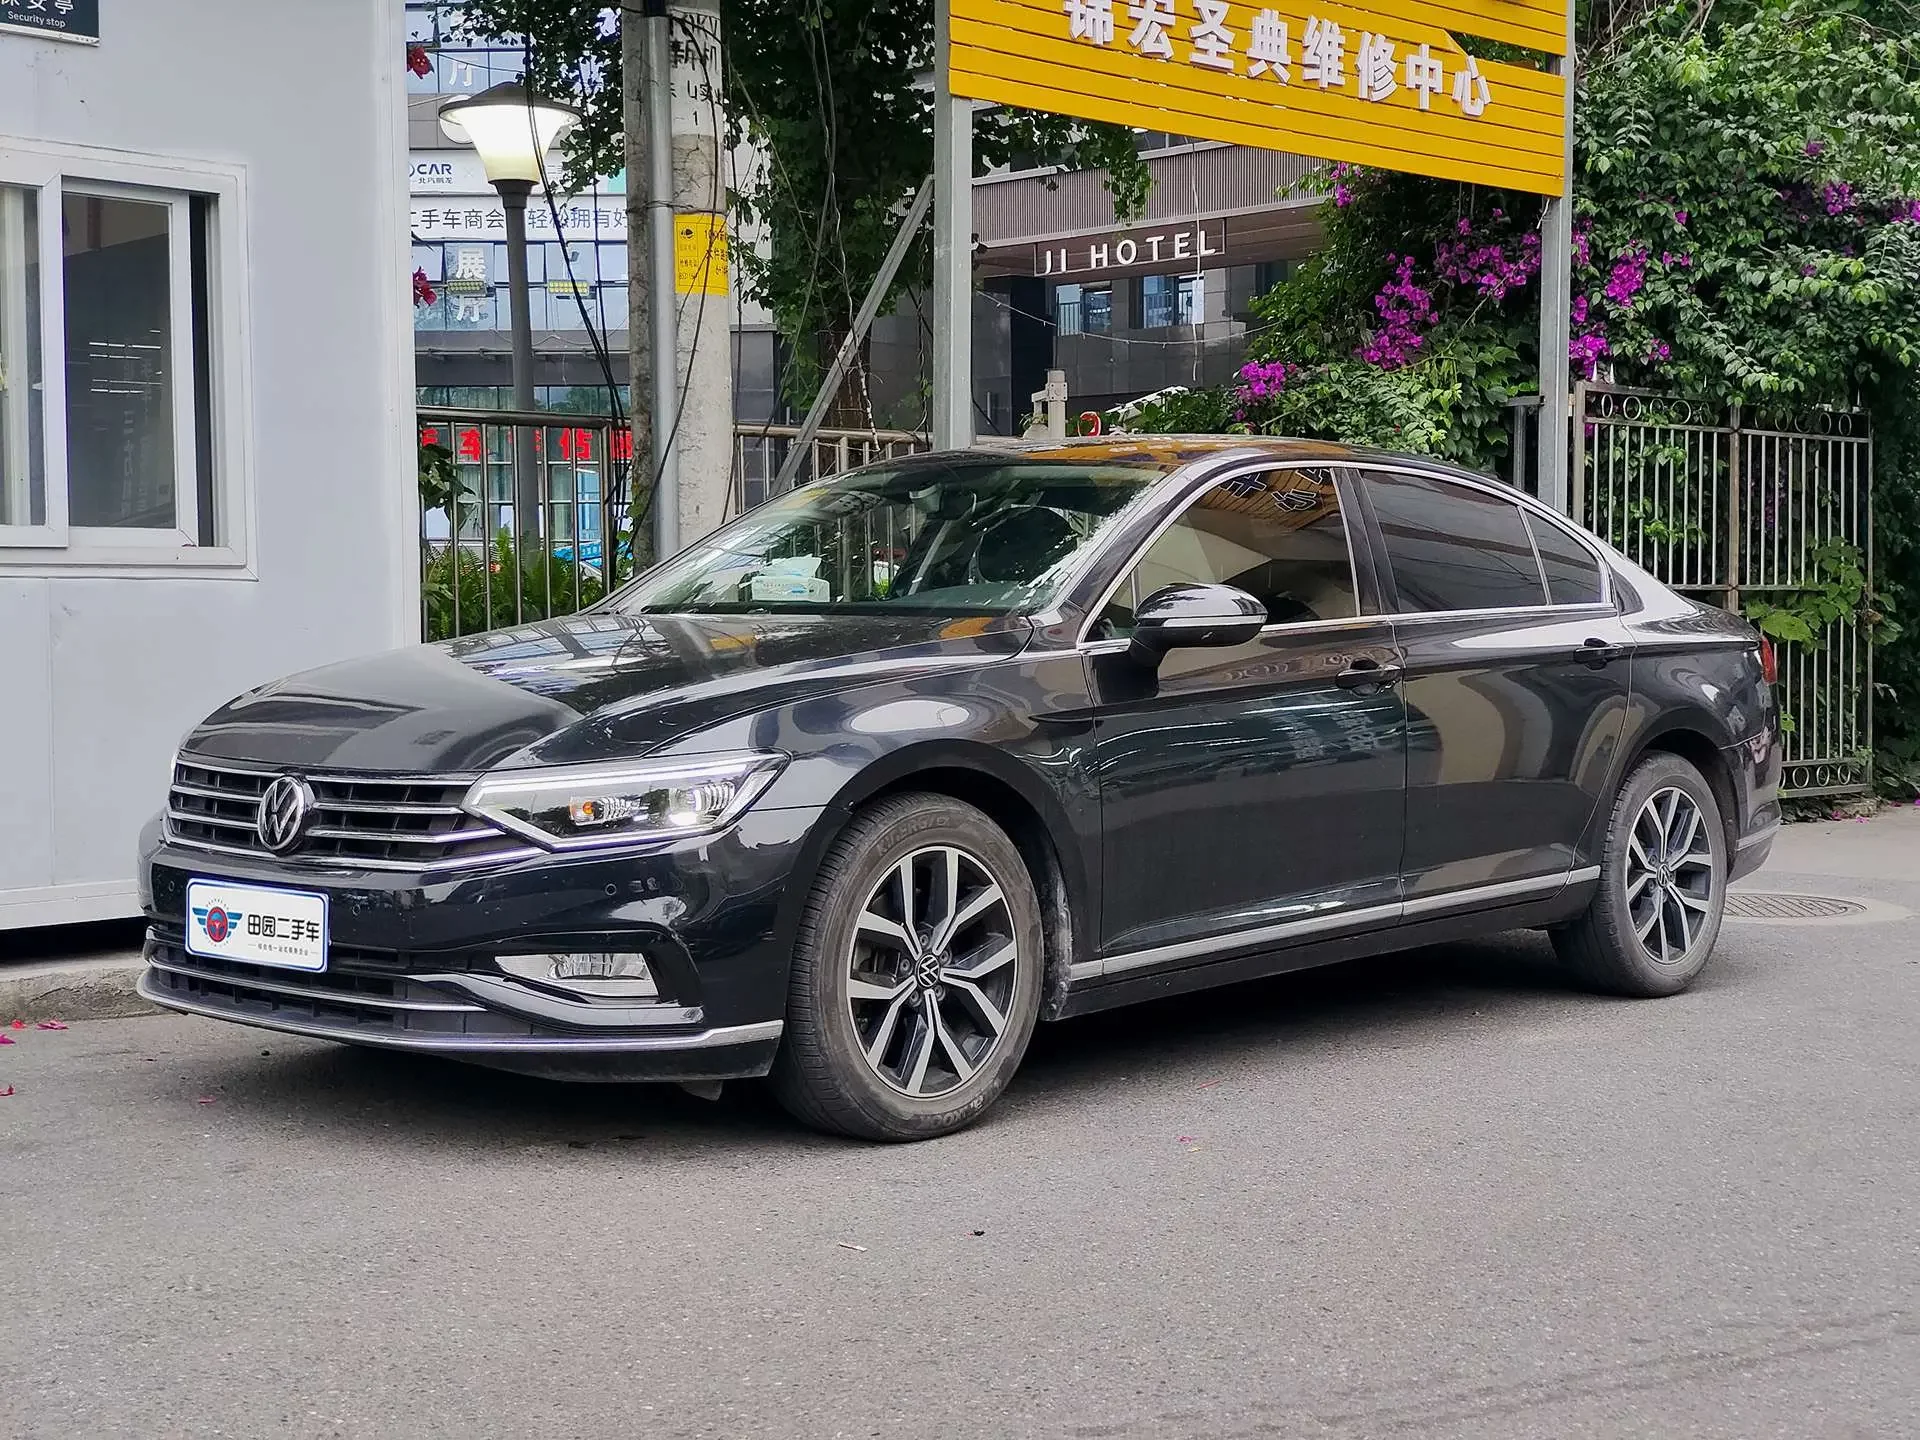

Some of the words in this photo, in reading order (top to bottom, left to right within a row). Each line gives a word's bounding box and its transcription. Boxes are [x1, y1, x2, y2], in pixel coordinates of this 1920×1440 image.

[7, 11, 44, 25] Security
[46, 18, 66, 28] stop
[1064, 0, 1491, 116] 锦宏圣典维修中心
[1045, 249, 1067, 274] JI
[1091, 231, 1216, 269] HOTEL
[247, 914, 319, 942] 田园二手车
